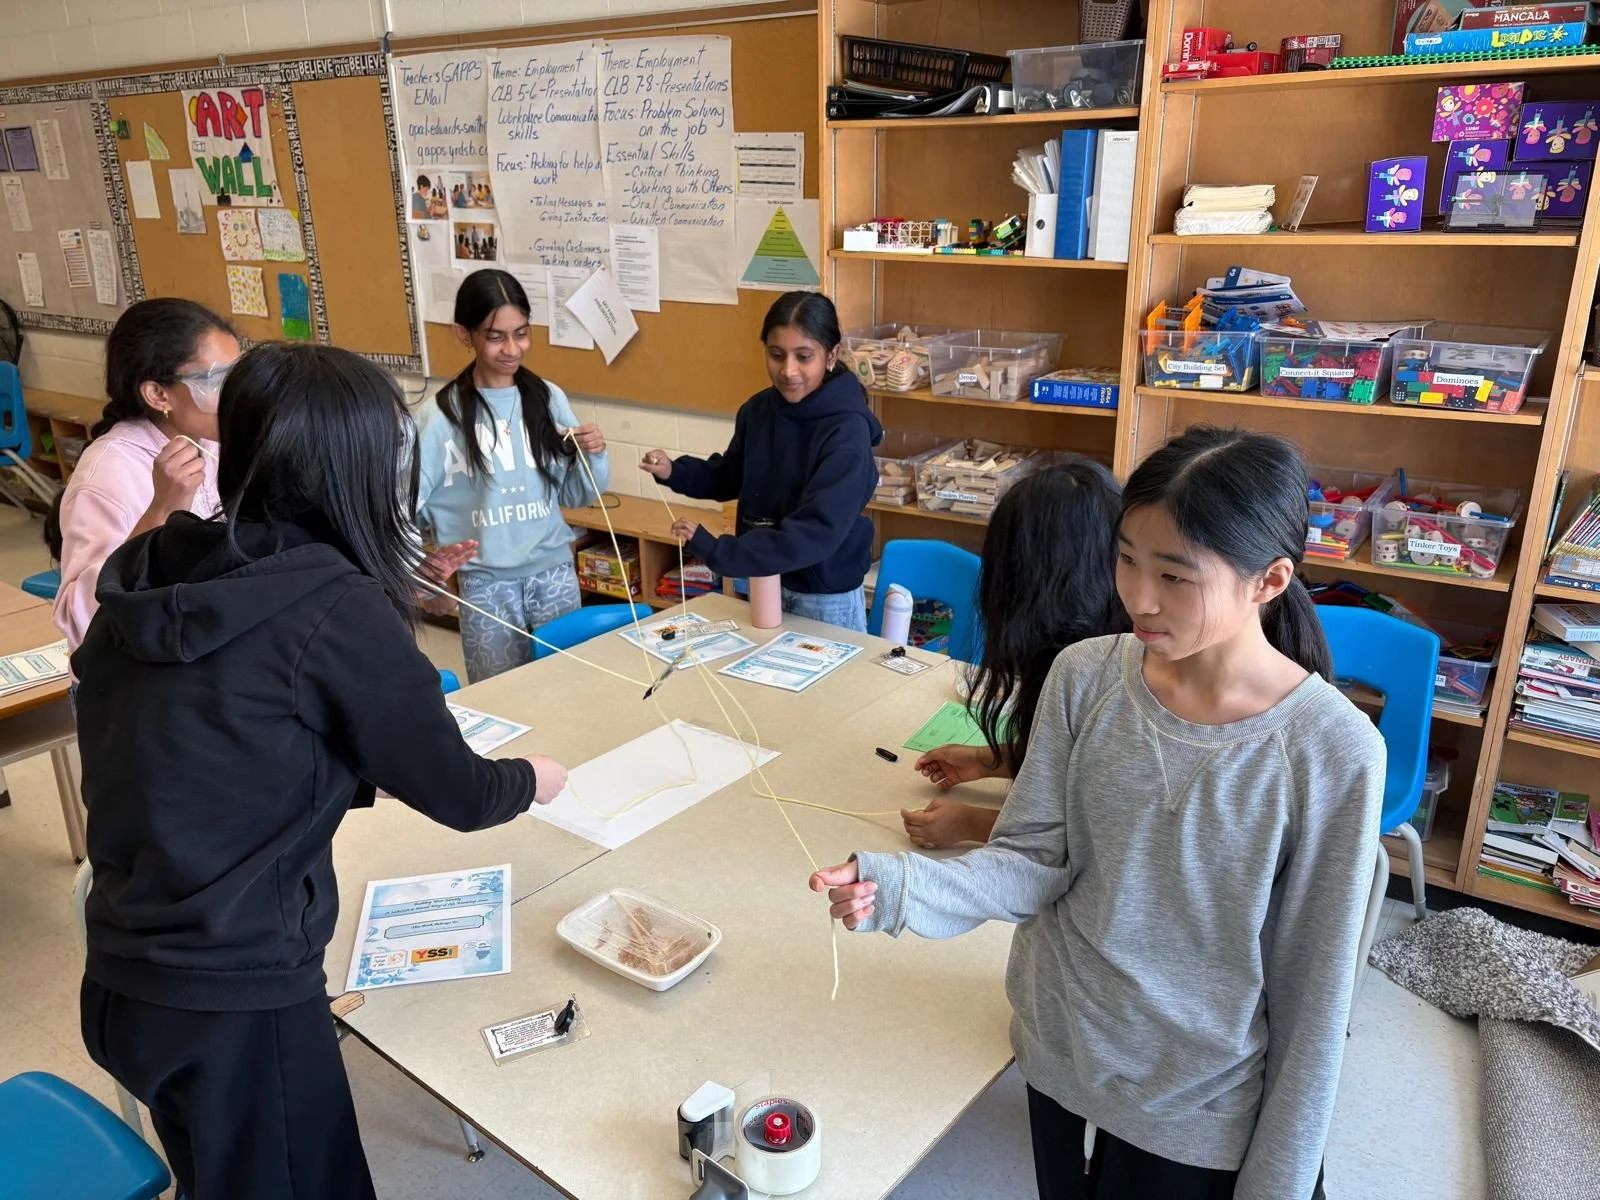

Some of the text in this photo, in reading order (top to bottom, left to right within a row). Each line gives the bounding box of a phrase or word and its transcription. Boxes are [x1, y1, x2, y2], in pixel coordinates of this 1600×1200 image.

[1494, 10, 1551, 23] MANCALA
[1184, 32, 1193, 63] Domin
[299, 59, 333, 75] BELIEVE
[350, 54, 386, 70] BELIEVE
[492, 51, 583, 79] Theme: Employment
[601, 45, 707, 73] Theme: Employment
[175, 71, 203, 85] BELIEVE
[204, 67, 236, 80] ACHIEVE
[286, 69, 299, 81] CAN
[442, 61, 482, 82] GAPPS
[492, 84, 512, 102] CLB
[604, 74, 629, 96] CLB
[196, 88, 264, 140] ART
[497, 103, 543, 126] Workplace
[603, 97, 725, 128] Focus: Problem Solving
[508, 125, 539, 140] skills
[639, 119, 707, 141] on the job
[606, 141, 695, 163] Essential Skills
[574, 150, 593, 175] help
[195, 154, 273, 197] WALL
[533, 173, 558, 185] work
[676, 179, 698, 193] with
[701, 177, 733, 194] Others
[1167, 363, 1181, 371] City
[1183, 364, 1213, 372] Building
[1322, 370, 1354, 378] Squares
[1436, 376, 1479, 385] Dominoes
[1410, 540, 1458, 552] Tinker Toys
